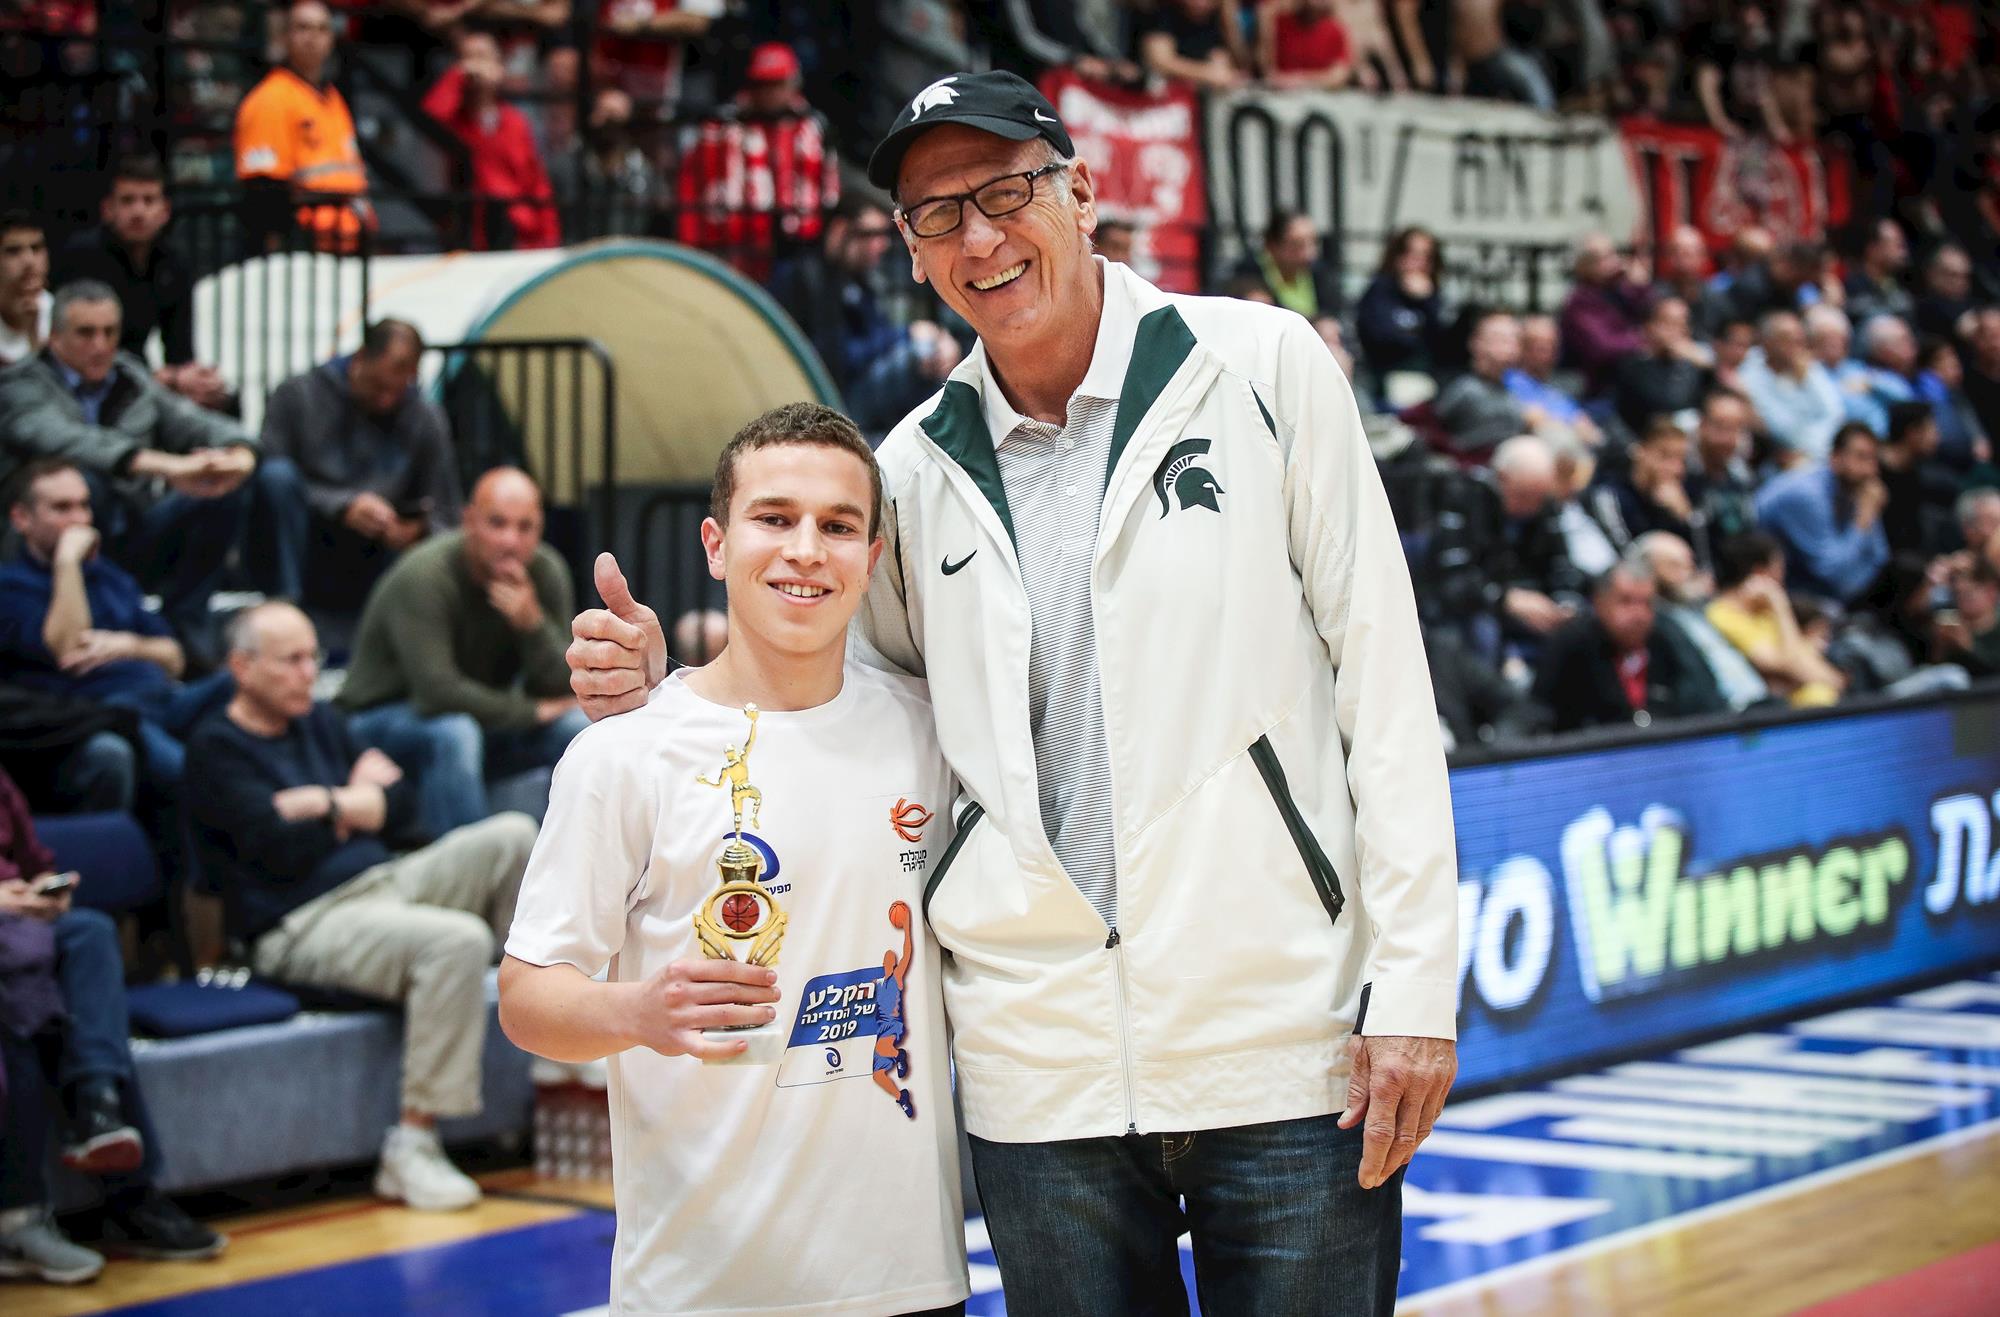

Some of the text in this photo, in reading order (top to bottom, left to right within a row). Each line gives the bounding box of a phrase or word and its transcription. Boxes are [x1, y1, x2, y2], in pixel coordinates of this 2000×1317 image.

[899, 849, 927, 862] מנהלת
[903, 860, 926, 872] הליגה
[1560, 804, 1908, 1002] Winner
[806, 982, 875, 1012] הקלע
[801, 1003, 876, 1025] של המדינה
[817, 1020, 857, 1041] 2019
